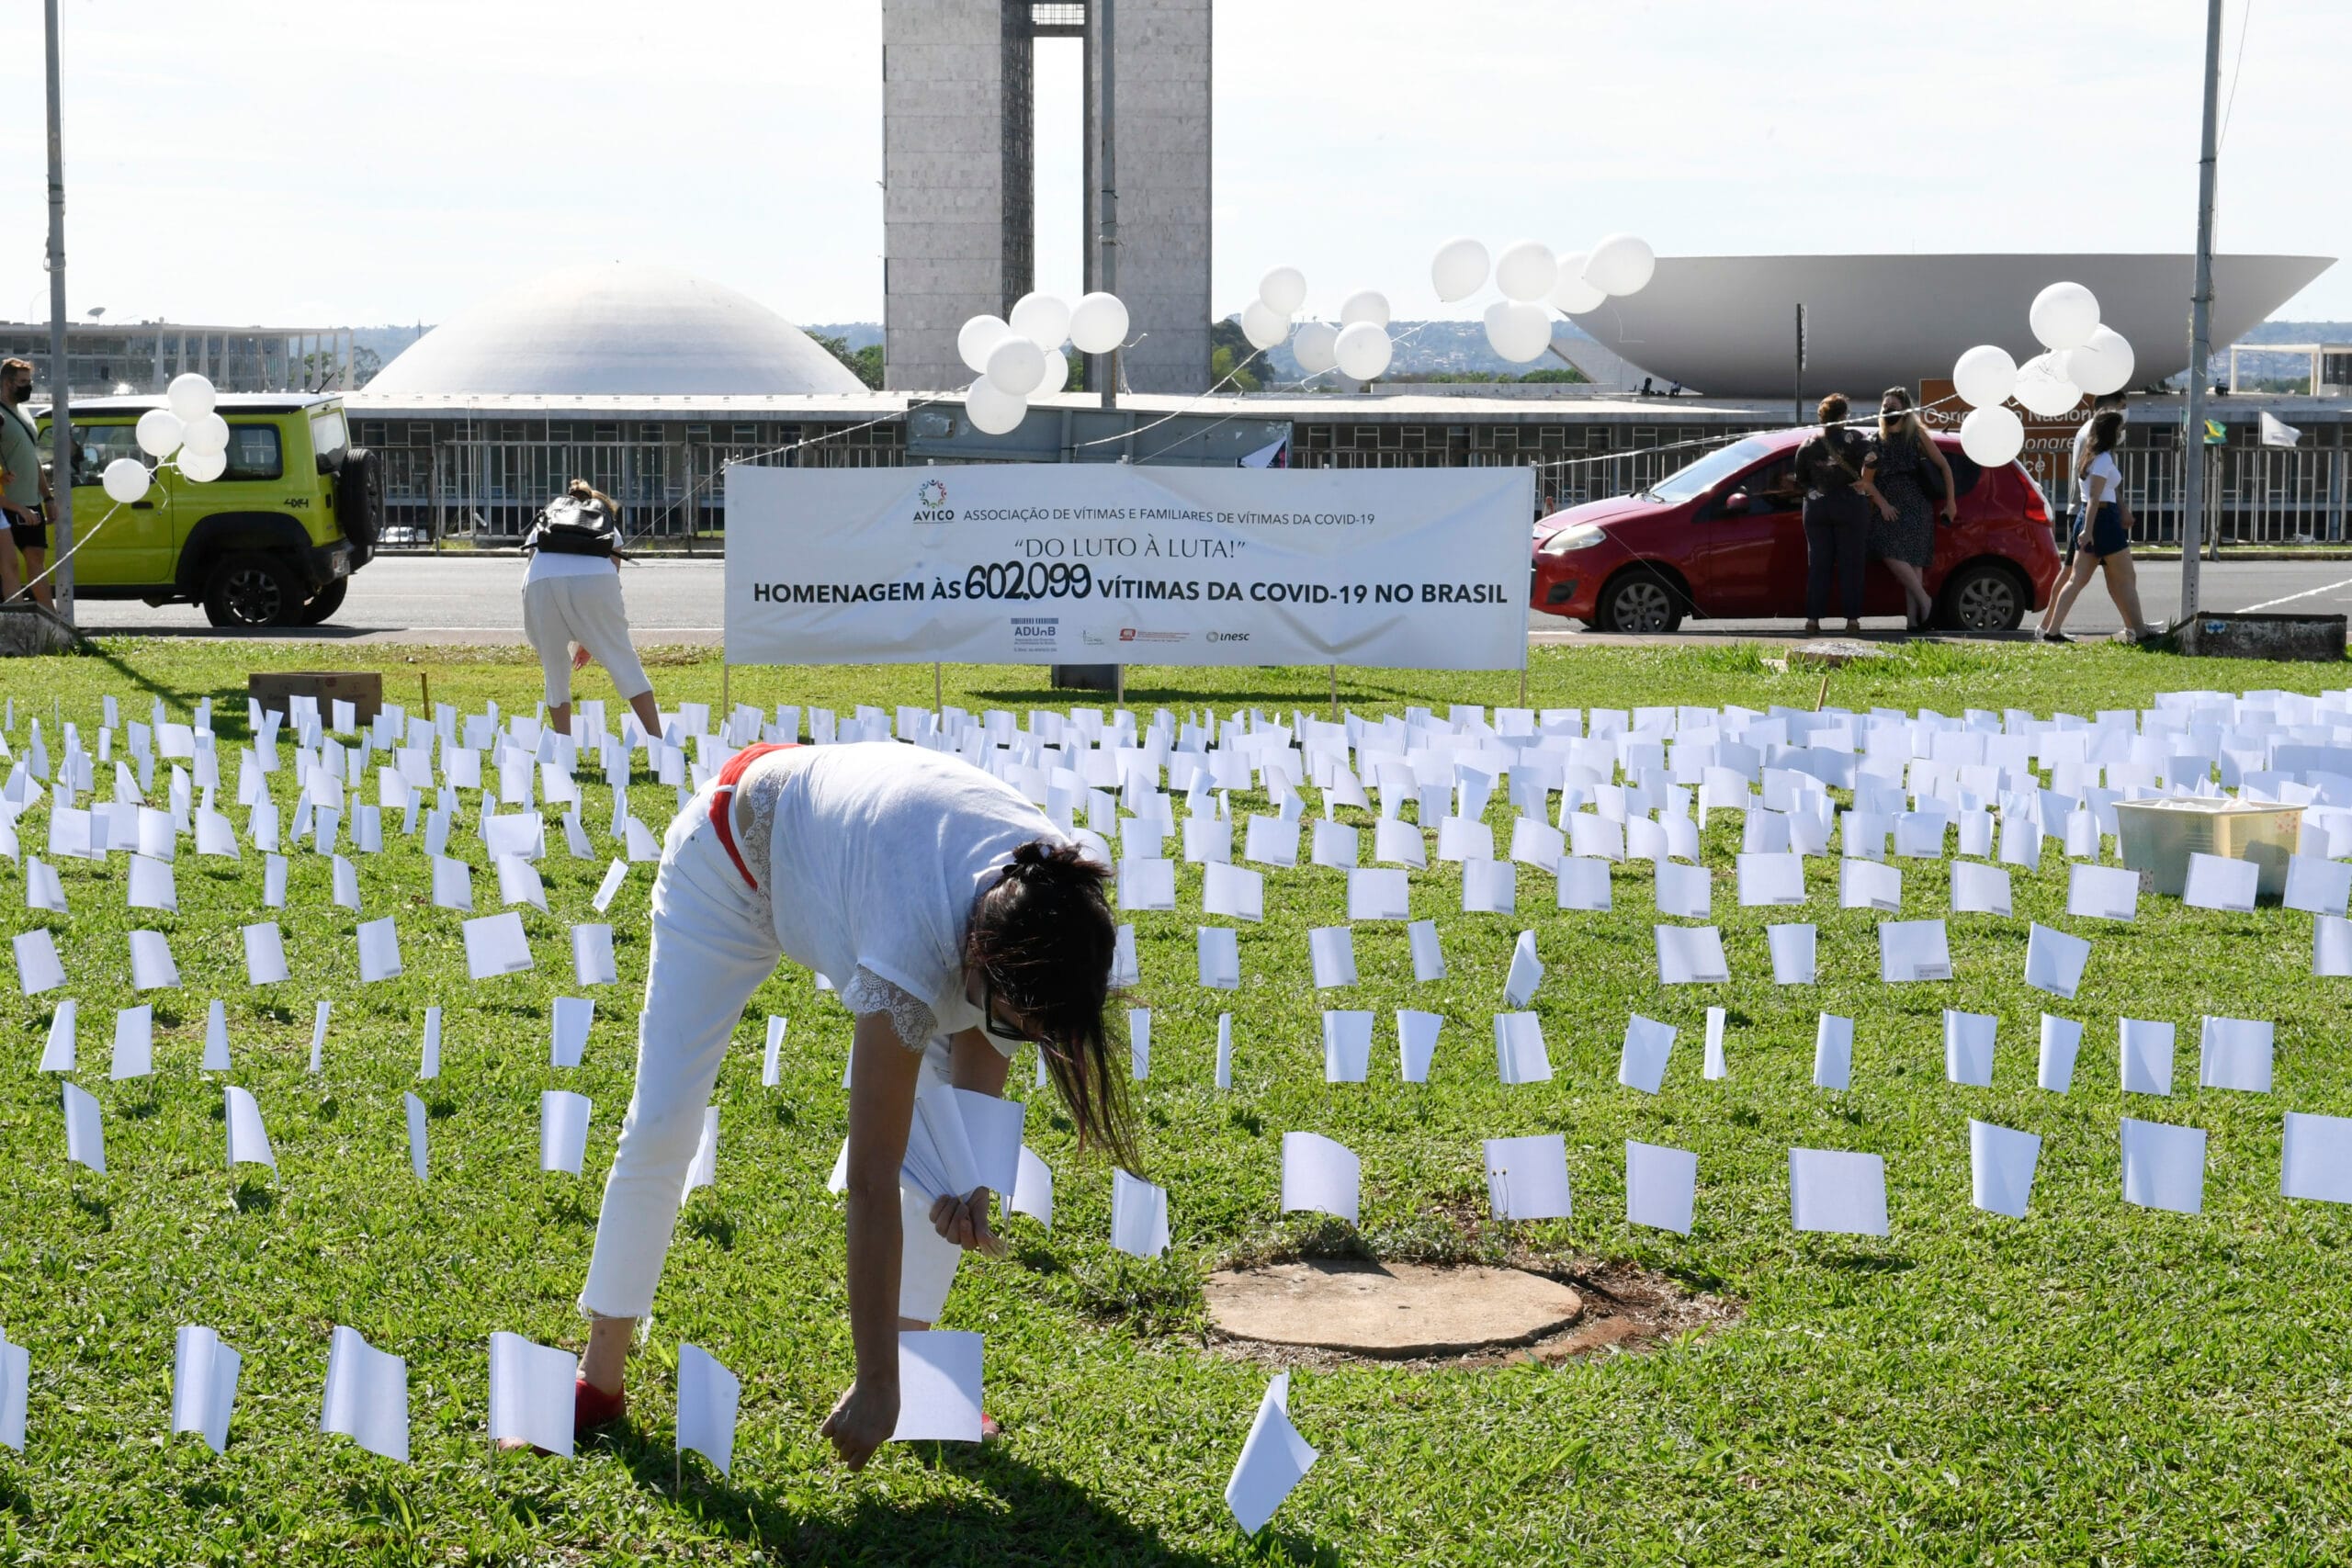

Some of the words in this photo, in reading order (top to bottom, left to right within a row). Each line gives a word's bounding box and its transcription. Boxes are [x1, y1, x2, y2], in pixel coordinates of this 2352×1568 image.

[912, 510, 955, 522] AVICO
[963, 507, 1049, 523] ASSOCIAÇÃO
[1053, 509, 1070, 520] DE
[1073, 506, 1125, 520] VÍTIMAS
[1129, 508, 1136, 519] E
[1139, 508, 1213, 523] FAMILIARES
[1216, 513, 1235, 524] DE
[1237, 511, 1289, 525] VÍTIMAS
[1293, 513, 1312, 525] DA
[1314, 513, 1375, 525] COVID-19
[1073, 537, 1136, 557] LUTO
[1144, 533, 1160, 557] À
[753, 581, 924, 604] HOMENAGEM
[931, 576, 961, 600] ÀS
[965, 561, 1092, 601] 602.099
[1097, 575, 1200, 600] VÍTIMAS
[1206, 581, 1244, 602] DA
[1250, 582, 1367, 604] COVID-19
[1374, 584, 1414, 604] NO
[1421, 583, 1508, 604] BRASIL
[1013, 626, 1057, 637] ADUnB
